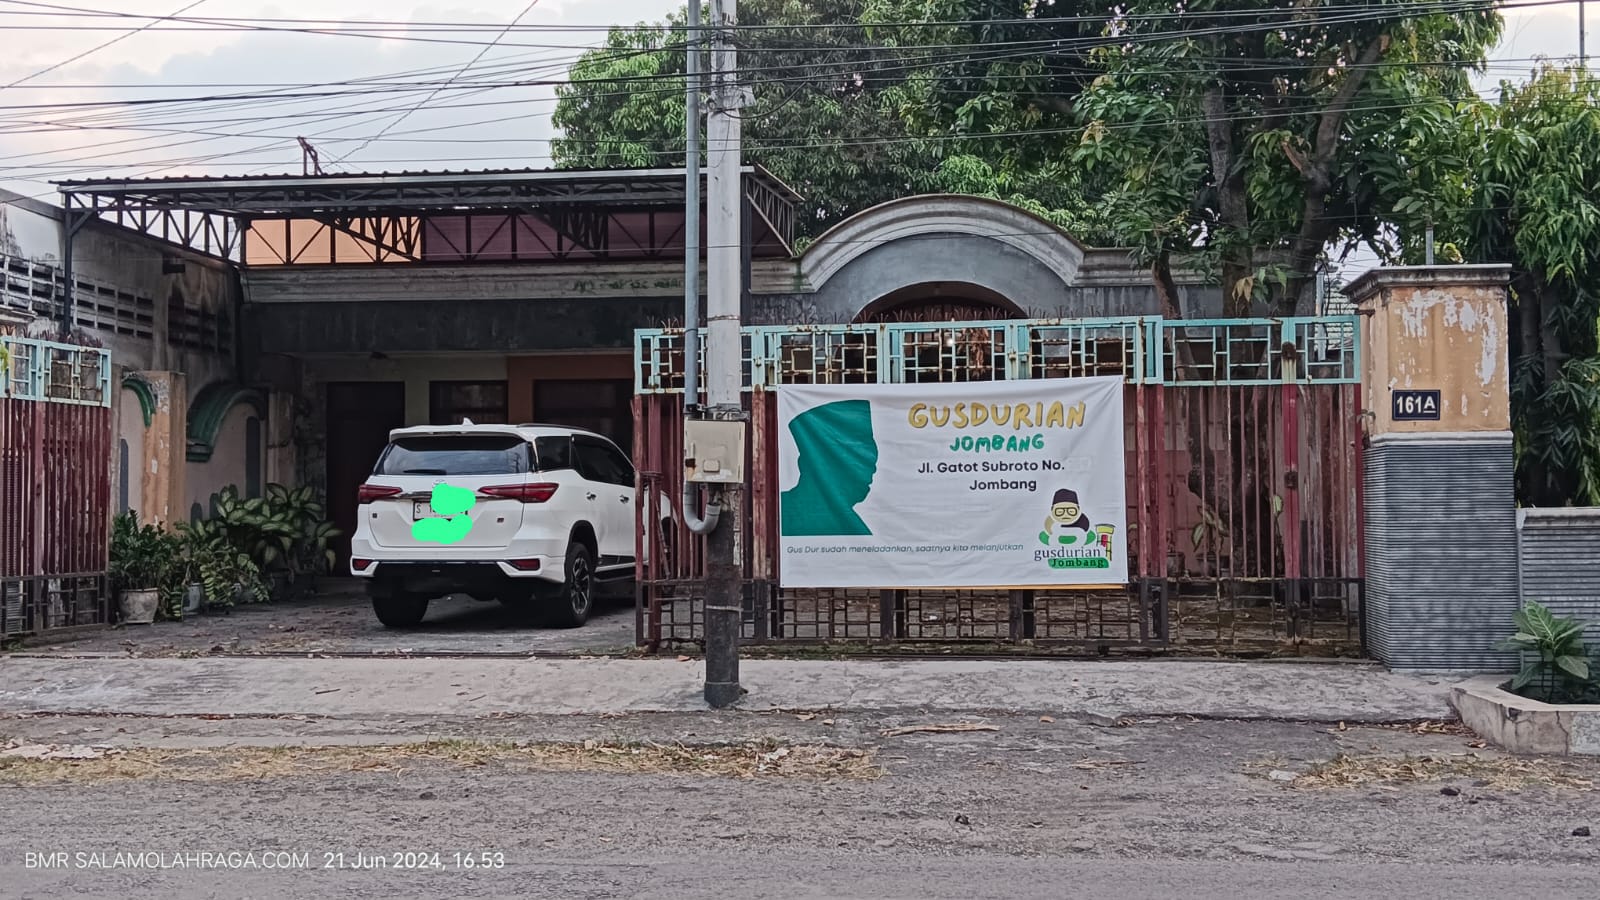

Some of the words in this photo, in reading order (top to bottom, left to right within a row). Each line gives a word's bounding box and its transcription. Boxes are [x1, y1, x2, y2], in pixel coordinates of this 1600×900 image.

[1396, 395, 1437, 414] 161A
[908, 401, 1087, 430] GUSDURIAN
[949, 433, 1045, 453] JOMBANG
[917, 462, 934, 474] Jl.
[937, 462, 979, 473] Gatot
[981, 460, 1039, 473] Subroto
[1041, 459, 1065, 472] No.
[969, 479, 1037, 492] Jombang
[786, 545, 803, 554] Gus
[804, 545, 820, 554] Dur
[820, 544, 847, 553] sudah
[915, 544, 951, 554] saatnya
[952, 543, 969, 552] kita
[970, 542, 1024, 553] melanjutkan
[1033, 546, 1101, 562] gusdurian
[1051, 557, 1105, 568] Jombang
